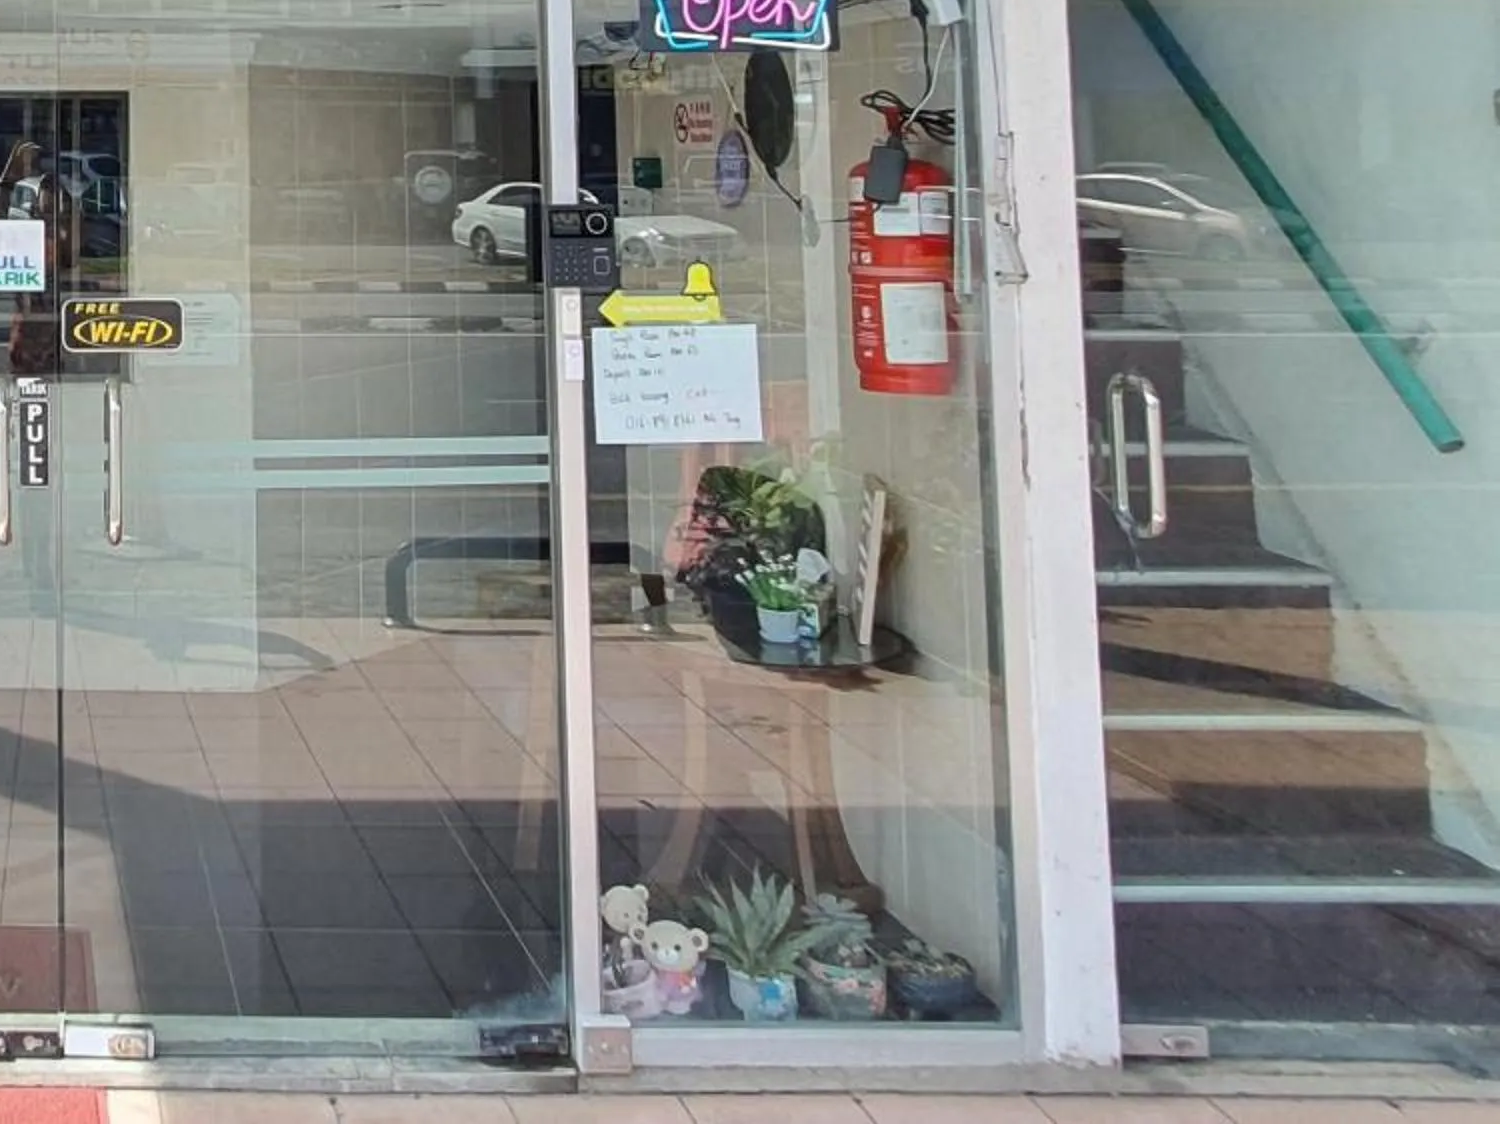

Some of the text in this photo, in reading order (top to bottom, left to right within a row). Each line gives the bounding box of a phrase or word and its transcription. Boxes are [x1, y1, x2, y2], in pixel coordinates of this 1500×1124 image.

[73, 303, 121, 315] FREE
[89, 321, 158, 343] WI-FI
[25, 403, 45, 485] PULL
